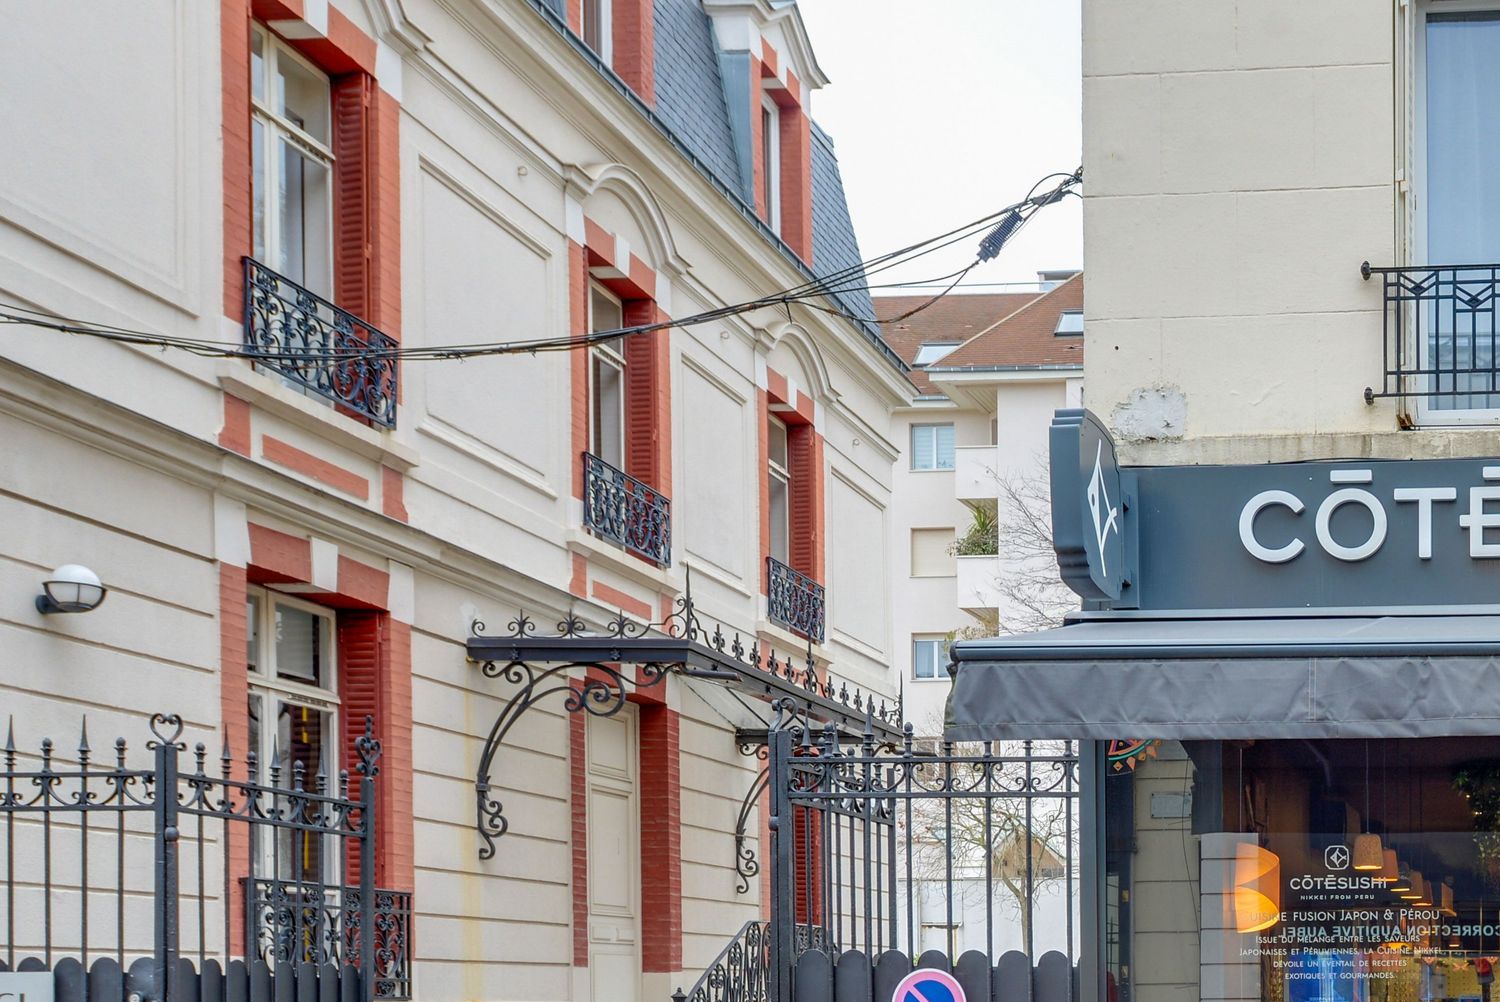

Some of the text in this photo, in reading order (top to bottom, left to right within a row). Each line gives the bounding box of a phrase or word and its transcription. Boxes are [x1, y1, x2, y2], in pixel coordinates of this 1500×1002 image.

[1293, 911, 1335, 922] FUSION
[1340, 909, 1378, 921] JAPON
[1383, 909, 1394, 920] &
[1400, 908, 1440, 920] PÉROU
